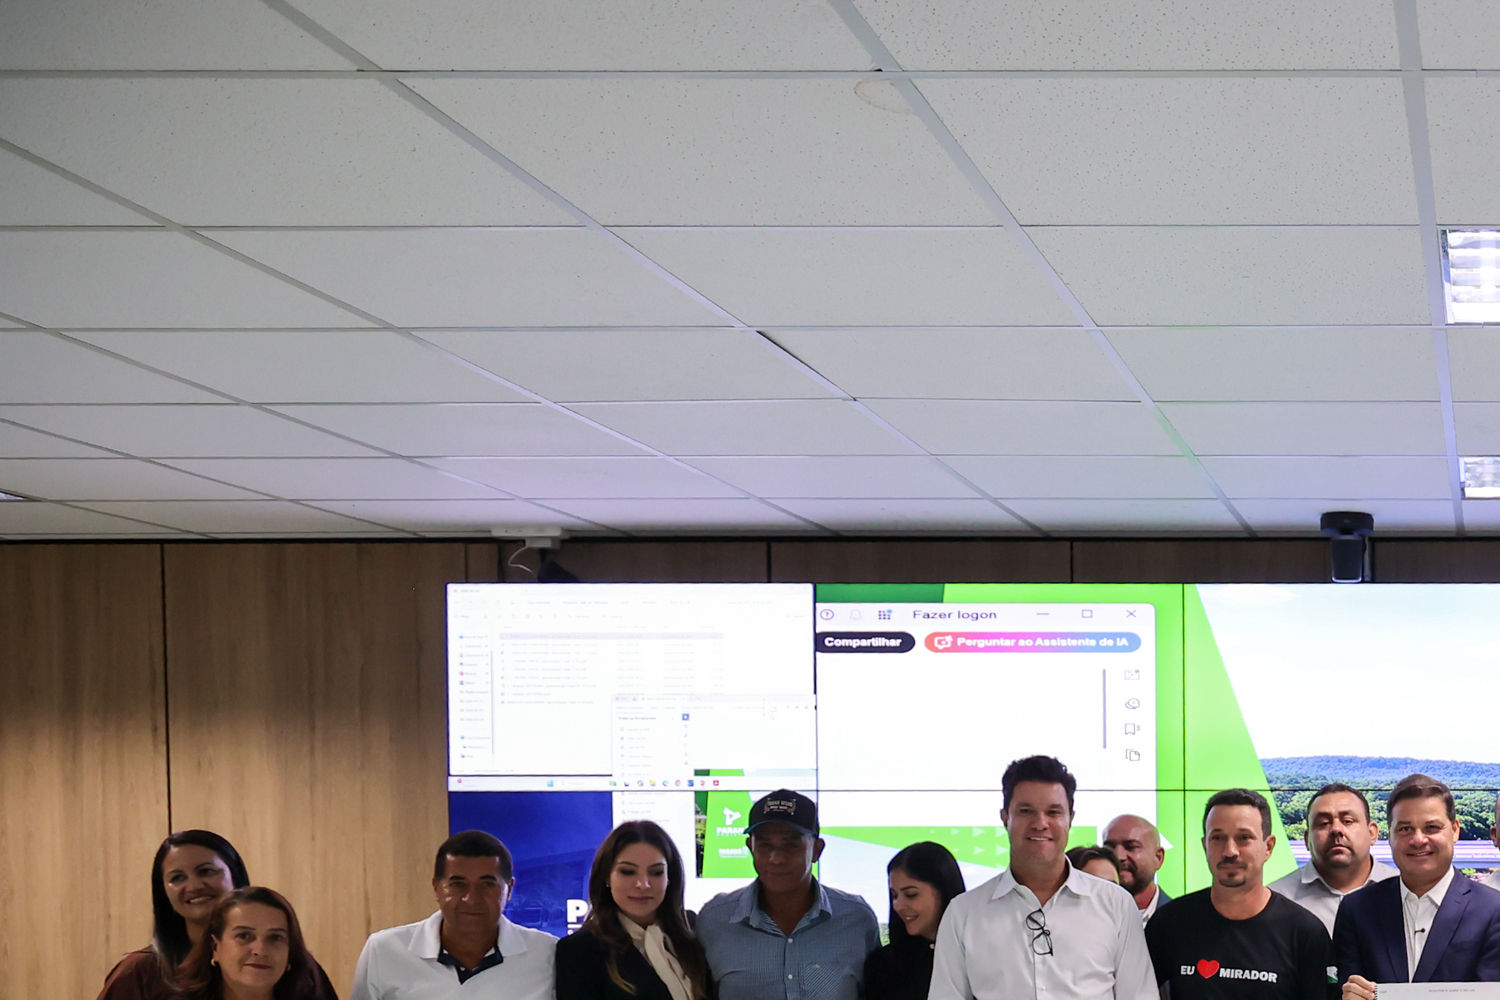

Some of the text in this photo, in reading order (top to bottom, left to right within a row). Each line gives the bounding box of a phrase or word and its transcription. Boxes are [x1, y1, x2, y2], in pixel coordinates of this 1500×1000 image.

[913, 609, 997, 621] Fazer logon
[823, 637, 902, 648] Compartilhar
[957, 637, 1015, 648] Perguntar
[1035, 637, 1097, 647] Assistente
[1099, 637, 1114, 647] de
[1116, 637, 1128, 647] IA
[1180, 965, 1278, 983] EU MIRADOR
